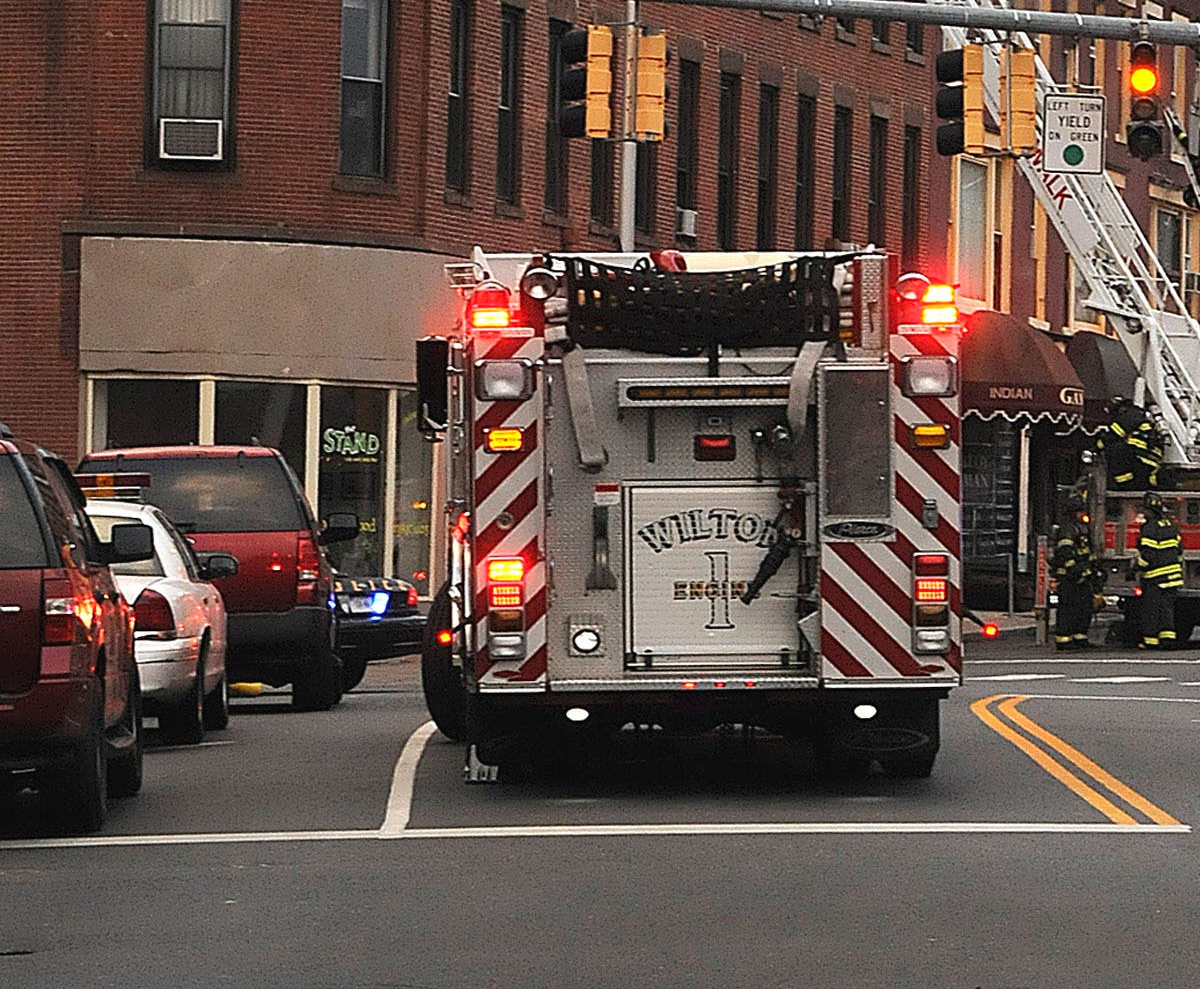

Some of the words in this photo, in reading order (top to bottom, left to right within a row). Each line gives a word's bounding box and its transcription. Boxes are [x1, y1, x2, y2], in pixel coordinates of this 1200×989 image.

[1047, 101, 1069, 111] LEFT
[1080, 103, 1101, 112] TURN
[1058, 115, 1091, 129] YIELD
[1048, 131, 1061, 141] ON
[1070, 132, 1099, 142] GREEN
[989, 387, 1033, 400] INDIAN
[323, 428, 380, 455] STAND
